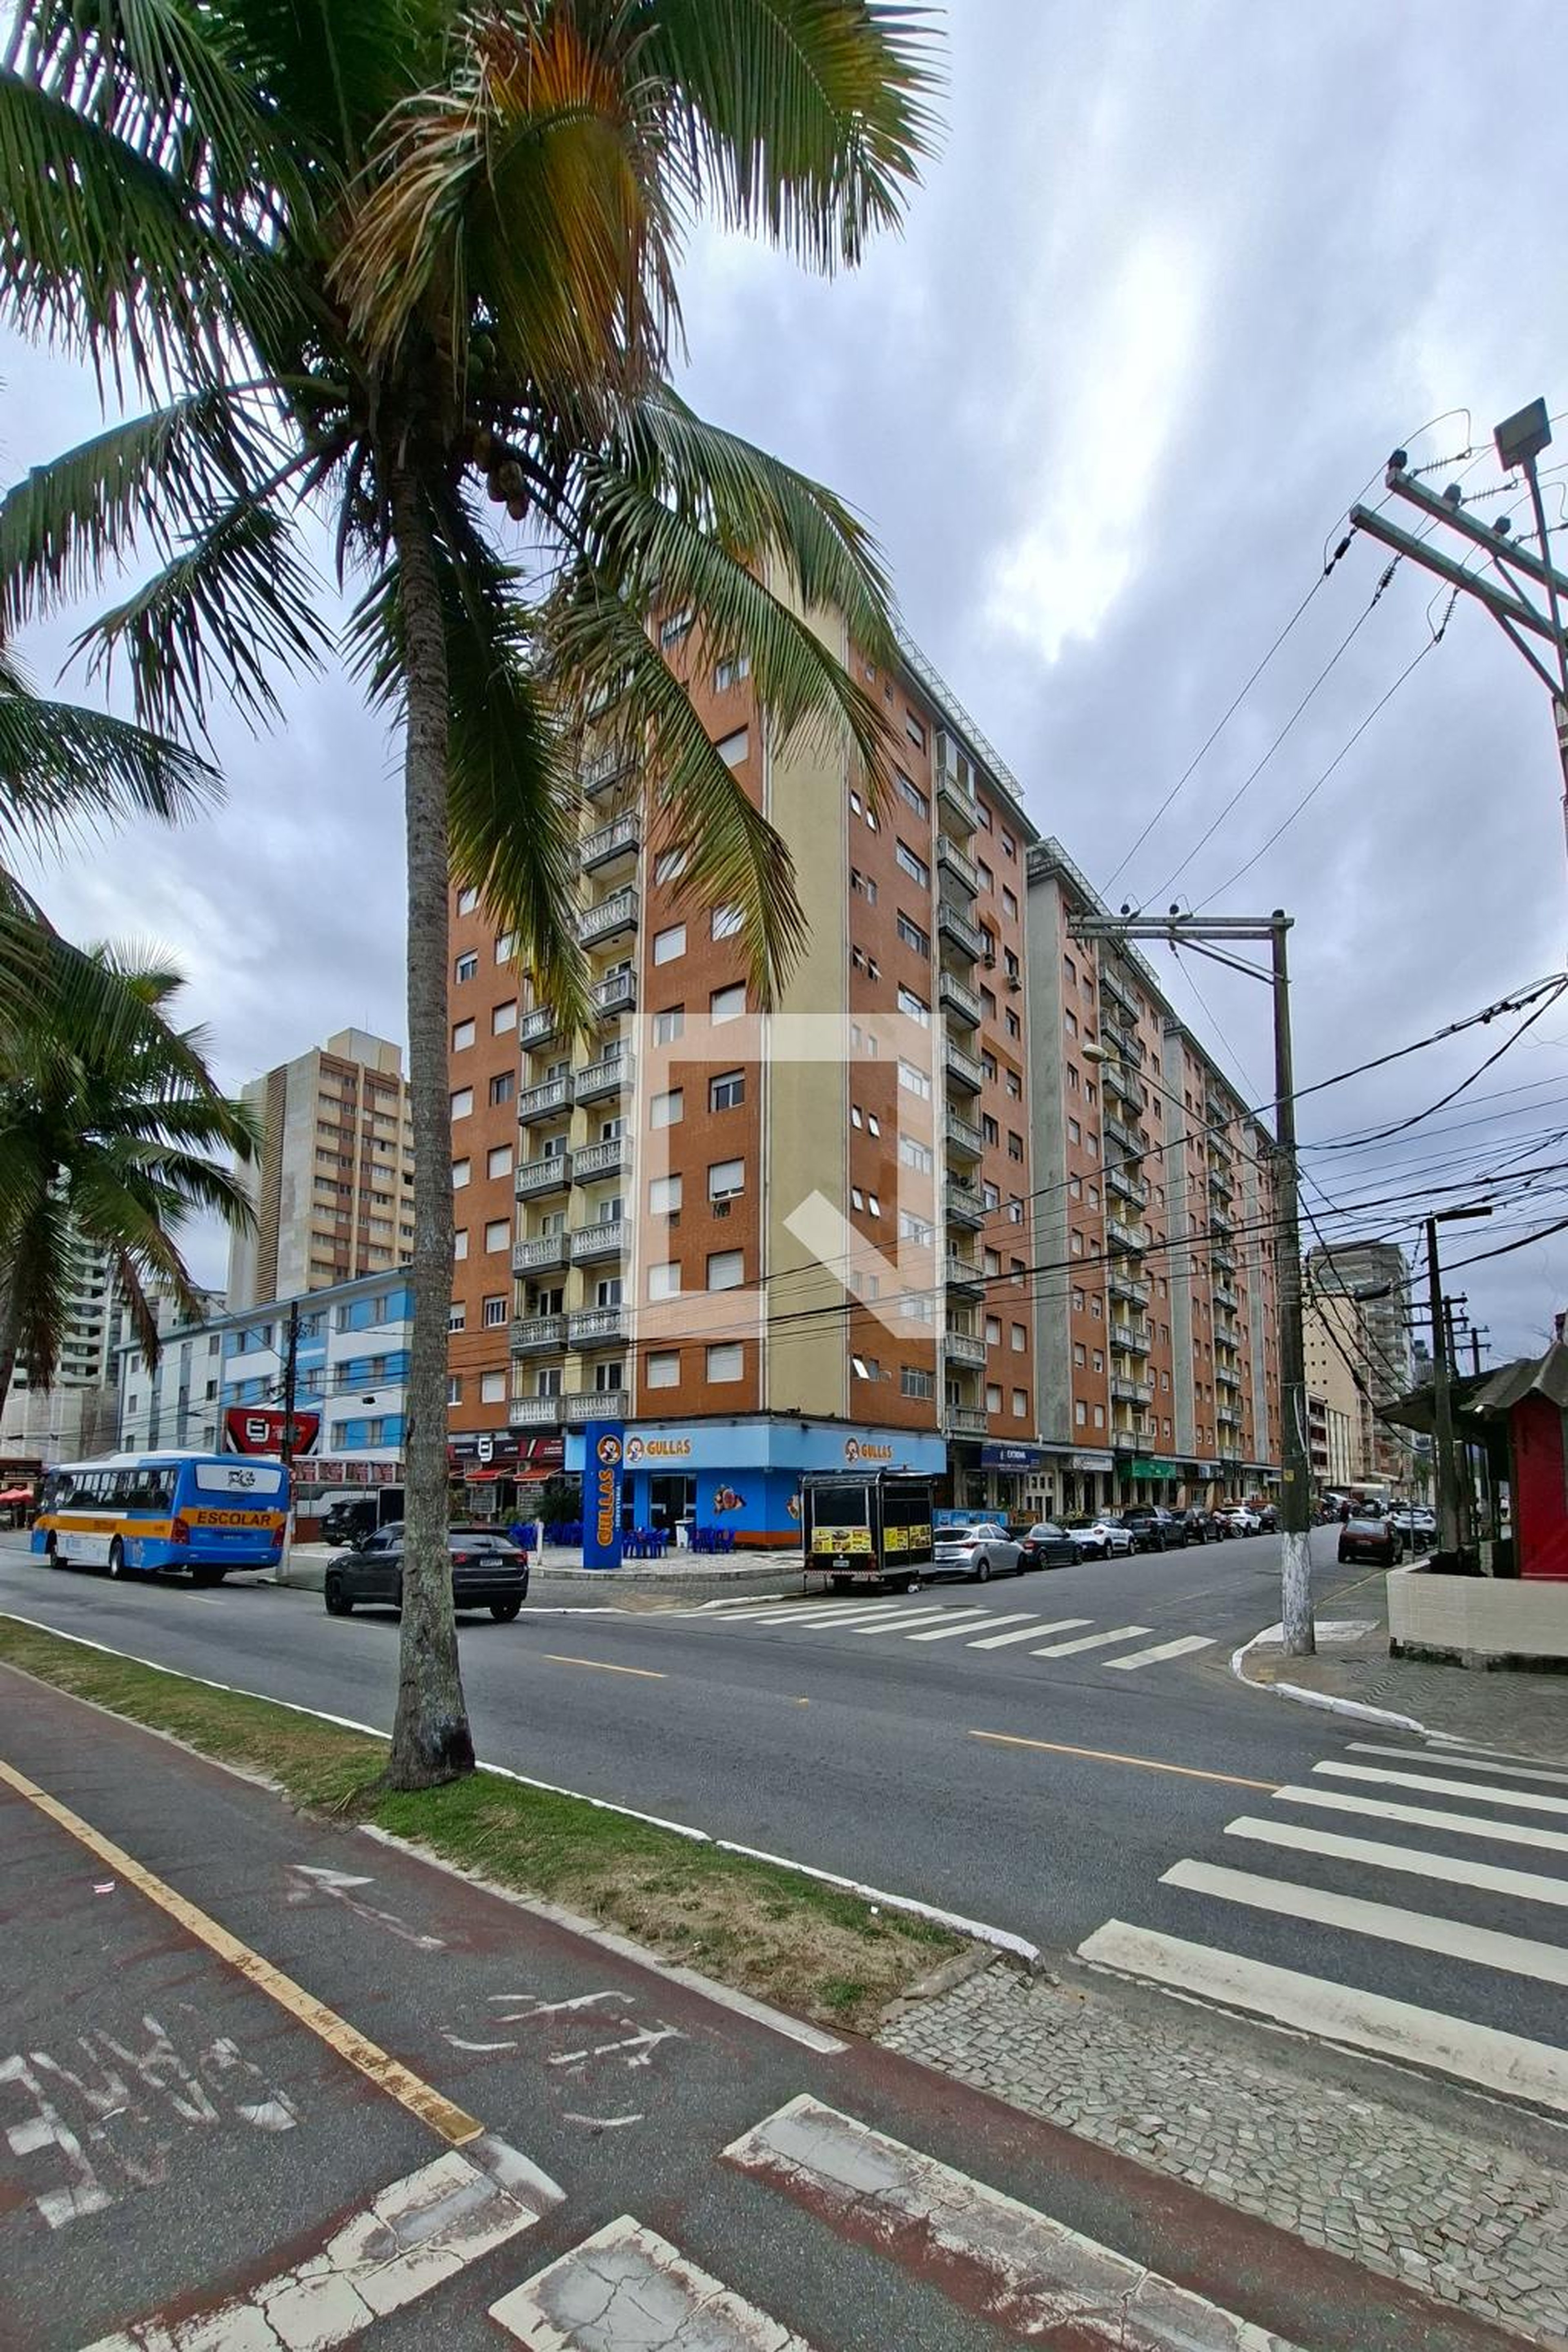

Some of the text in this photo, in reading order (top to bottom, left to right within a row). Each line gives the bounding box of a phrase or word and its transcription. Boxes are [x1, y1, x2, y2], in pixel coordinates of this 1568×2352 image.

[645, 1439, 691, 1456] GULLAS
[860, 1443, 893, 1459] GULLAS
[598, 1469, 614, 1545] GULLAS
[197, 1511, 271, 1526] ESCOLAR
